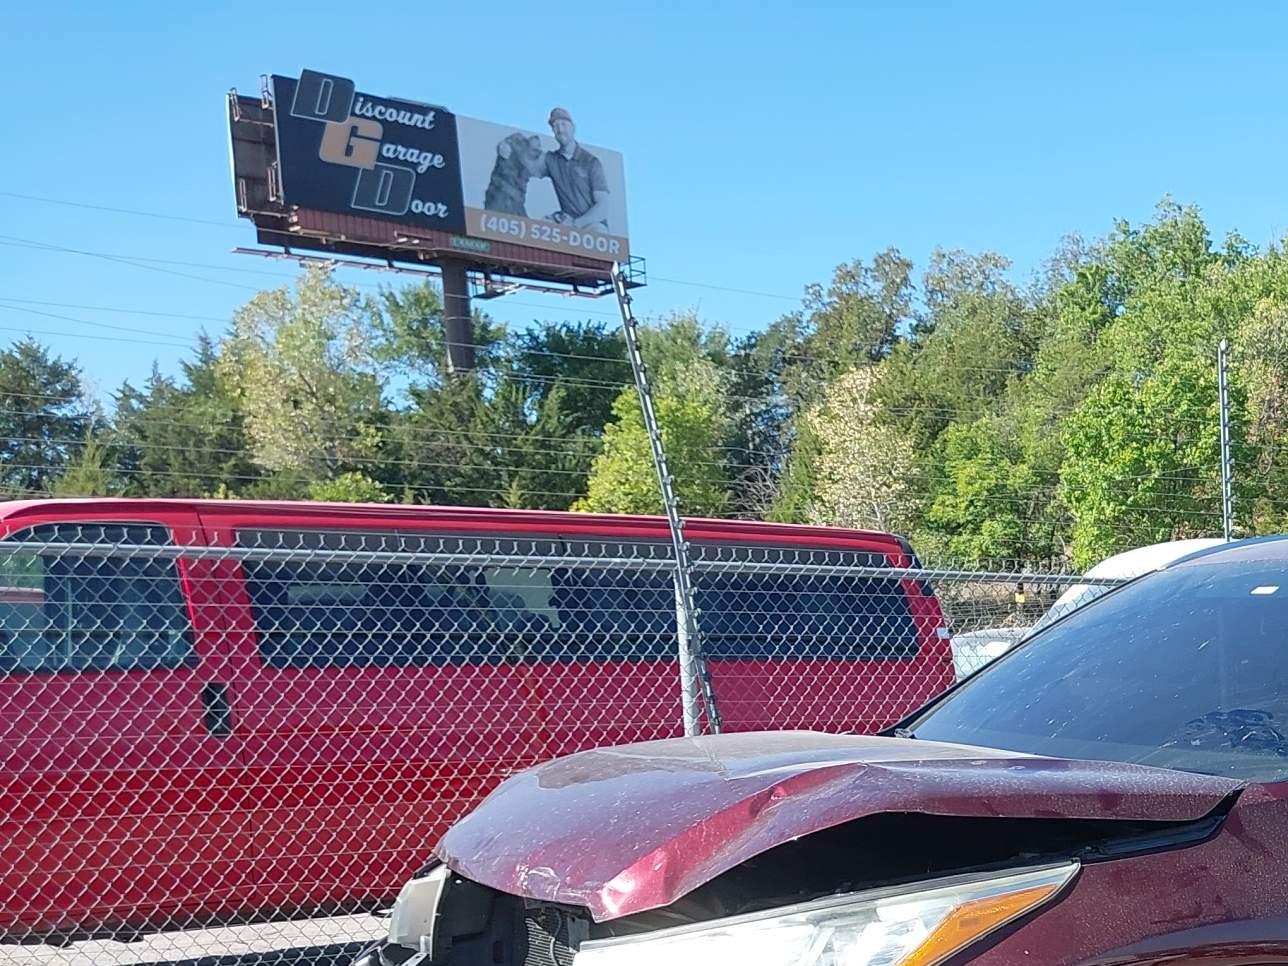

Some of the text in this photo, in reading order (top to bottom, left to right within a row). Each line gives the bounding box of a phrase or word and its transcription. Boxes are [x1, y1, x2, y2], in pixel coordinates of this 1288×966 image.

[290, 68, 436, 130] Discount
[319, 116, 446, 174] Garage
[351, 161, 449, 218] Door
[480, 213, 621, 255] (405) 525-DOOR
